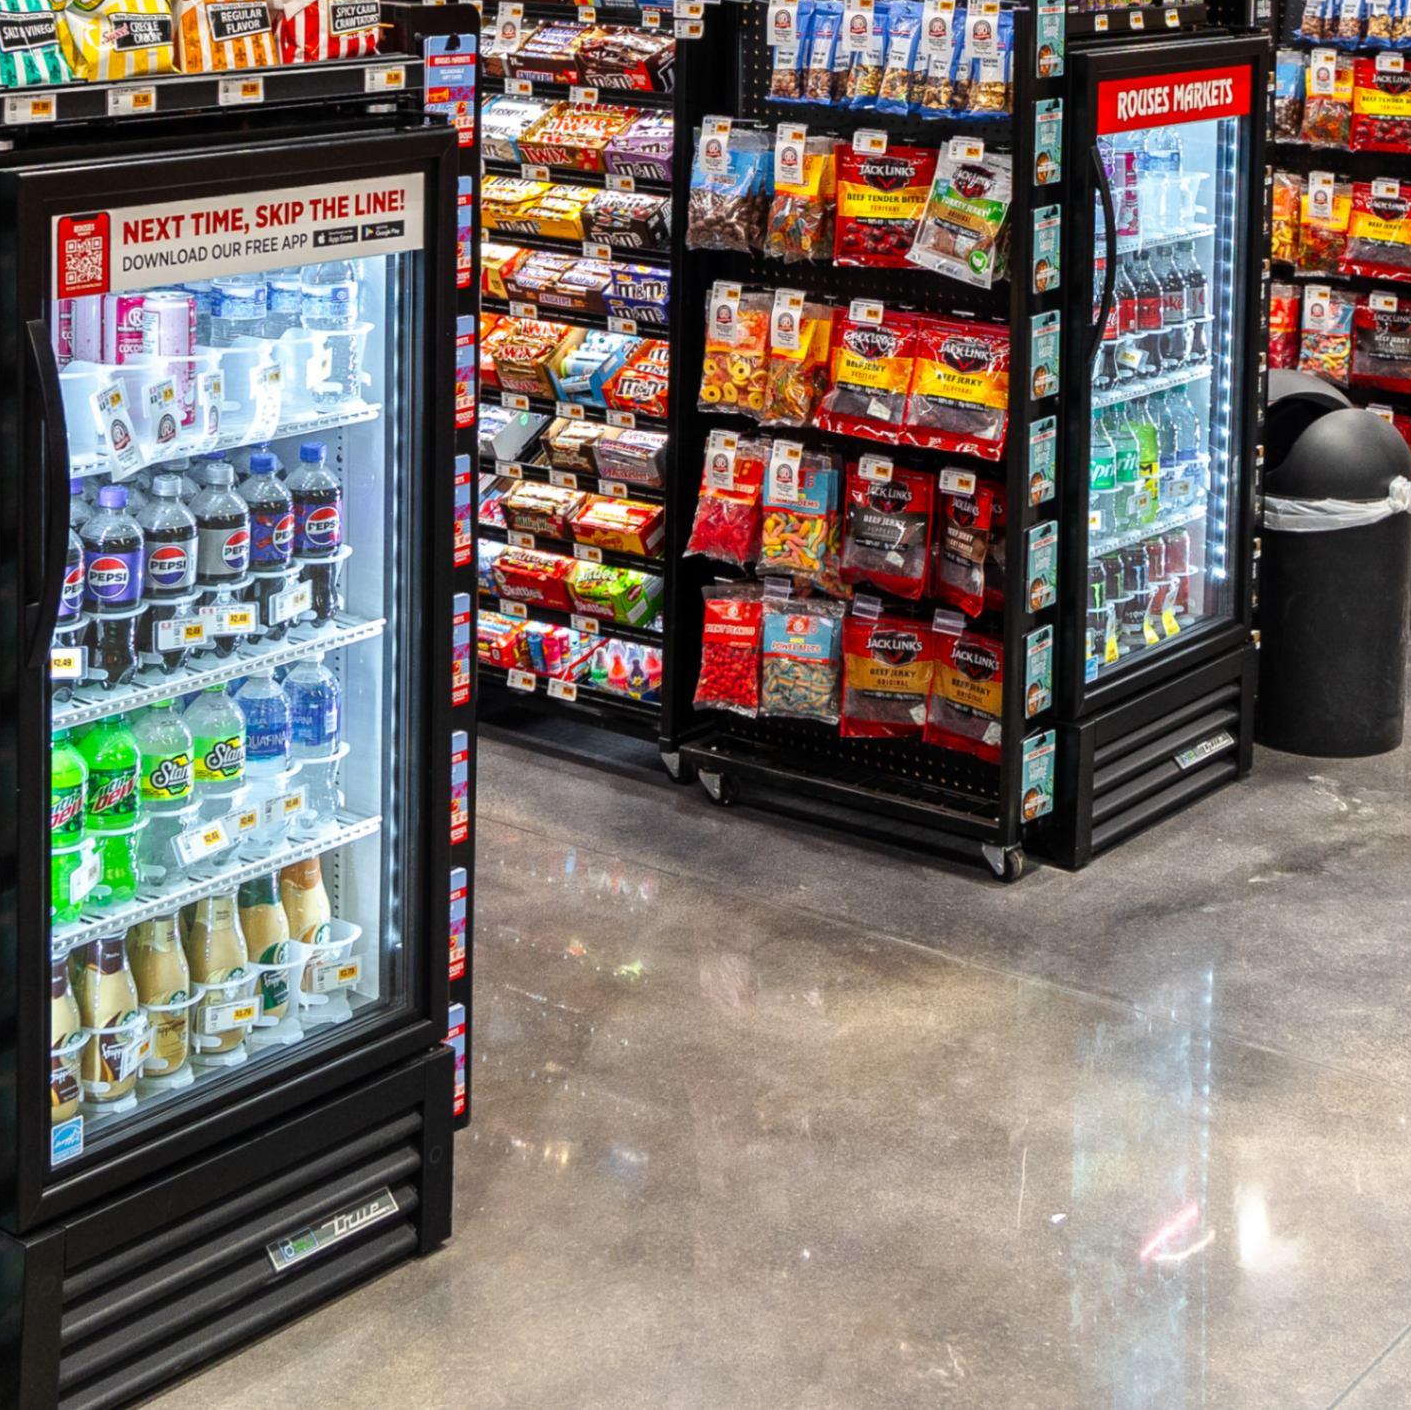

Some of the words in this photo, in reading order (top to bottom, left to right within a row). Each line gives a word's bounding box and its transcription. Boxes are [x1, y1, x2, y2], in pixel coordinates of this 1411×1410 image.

[221, 8, 263, 23] REGULAR
[26, 22, 56, 37] VINEGA
[225, 20, 261, 34] FLAVOR
[1117, 85, 1170, 123] ROUSES
[1172, 77, 1234, 113] MARKETS
[858, 163, 884, 177] JACK
[847, 193, 866, 204] BEEF
[867, 193, 899, 204] TENDER
[123, 214, 186, 245] NEXT
[190, 208, 250, 238] TIME,
[255, 201, 305, 229] SKIP
[308, 195, 351, 221] THE
[354, 188, 406, 216] LINE!
[123, 245, 208, 272] DOWNLOAD
[211, 240, 242, 260] OUR
[245, 236, 278, 256] FREE
[281, 232, 309, 252] APP
[150, 560, 187, 571] PEPSI
[89, 571, 128, 583] PEPSI
[866, 638, 891, 651] JACK
[870, 667, 890, 677] BEEF
[891, 668, 916, 679] JERKY
